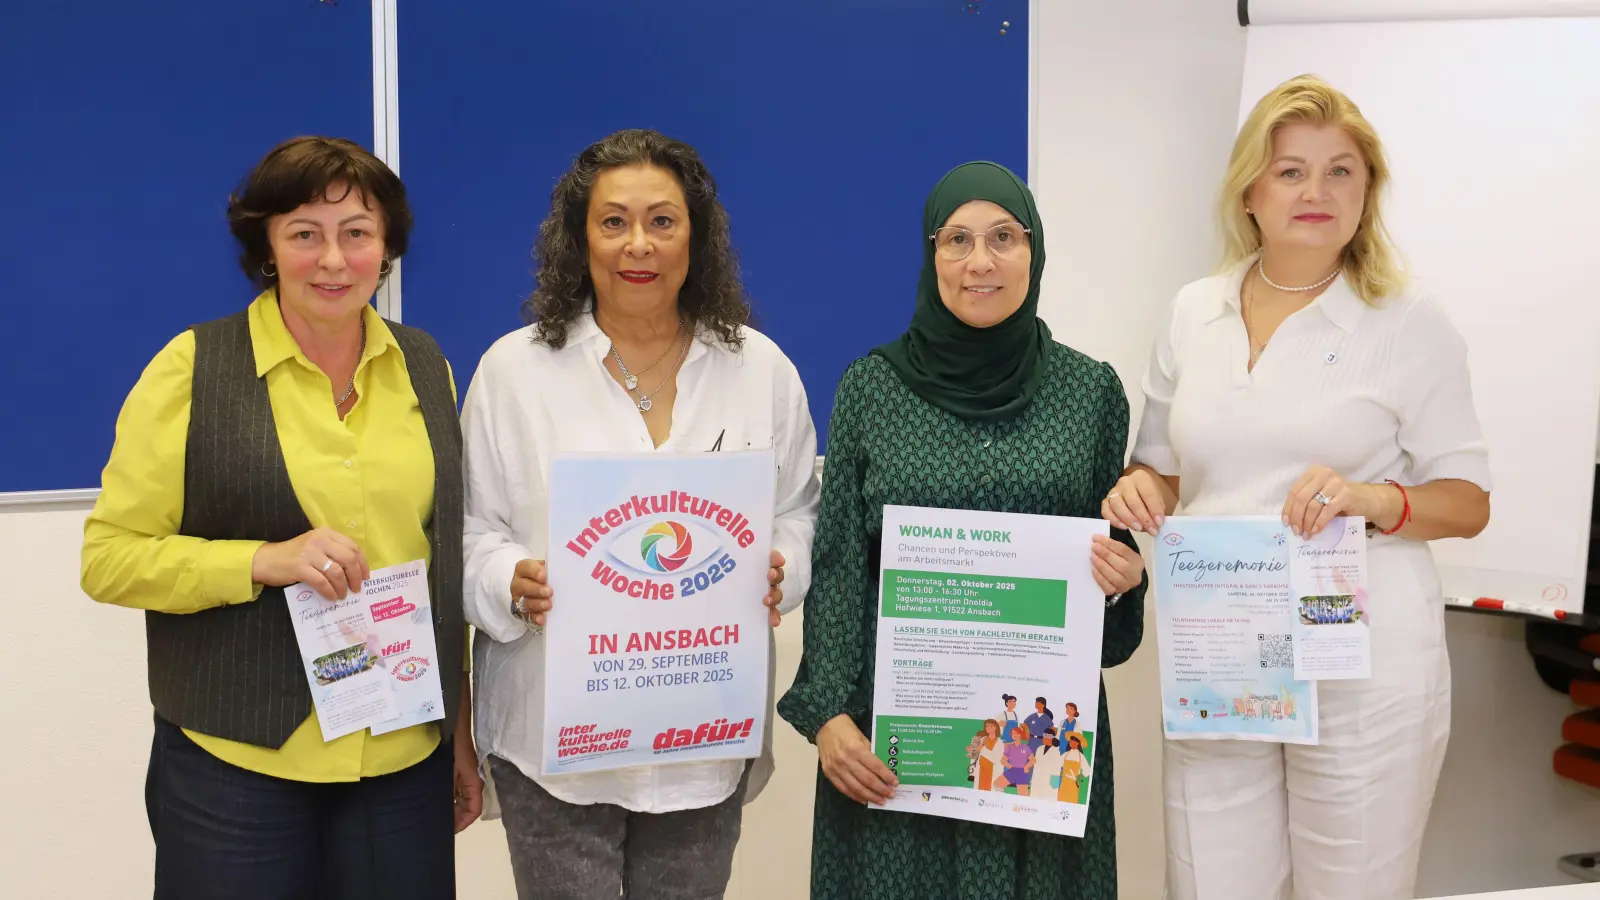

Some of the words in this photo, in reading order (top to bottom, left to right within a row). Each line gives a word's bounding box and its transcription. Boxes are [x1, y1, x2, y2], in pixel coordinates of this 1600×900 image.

[565, 490, 755, 558] Interkulturelle
[898, 525, 953, 539] WOMAN
[956, 528, 966, 540] &
[970, 529, 1012, 543] WORK
[898, 543, 936, 553] Chancen
[939, 546, 956, 555] und
[958, 547, 1017, 559] Perspektiven
[1297, 544, 1359, 560] Teezeremonie
[913, 555, 974, 567] Arbeitsmarkt
[1168, 550, 1287, 582] Teezeremonie
[363, 568, 420, 588] NTERKULTURELLE
[392, 580, 409, 590] 2025
[591, 559, 675, 601] Woche
[680, 553, 737, 598] 2025
[896, 575, 945, 587] Donnerstag,
[946, 578, 959, 587] 02.
[961, 579, 994, 589] Oktober
[995, 582, 1016, 590] 2025
[912, 586, 933, 594] 13:00
[942, 587, 962, 595] 16:30
[964, 588, 979, 597] Uhr
[372, 599, 400, 613] September
[896, 594, 961, 605] Tagungszentrum
[963, 598, 993, 607] Onoldia
[390, 605, 412, 615] Oktober
[895, 604, 932, 613] Hofwiese
[934, 605, 941, 614] 1,
[942, 606, 966, 615] 91522
[967, 607, 1001, 617] Ansbach
[588, 633, 618, 655] IN
[625, 624, 739, 653] ANSBACH
[894, 625, 925, 634] LASSEN
[926, 627, 939, 635] SIE
[940, 628, 958, 636] SICH
[976, 629, 1027, 640] FACHLEUTEN
[1028, 633, 1064, 643] BERATEN
[593, 659, 624, 673] VON
[628, 657, 648, 671] 29.
[652, 651, 729, 669] SEPTEMBER
[892, 657, 934, 668] VORTRÄGE
[586, 678, 609, 692] BIS
[613, 676, 631, 690] 12.
[635, 671, 699, 688] OKTOBER
[702, 668, 734, 683] 2025
[557, 727, 633, 748] kulturelle
[558, 722, 597, 738] inter
[652, 717, 755, 750] dafür!
[557, 740, 629, 758] woche.de
